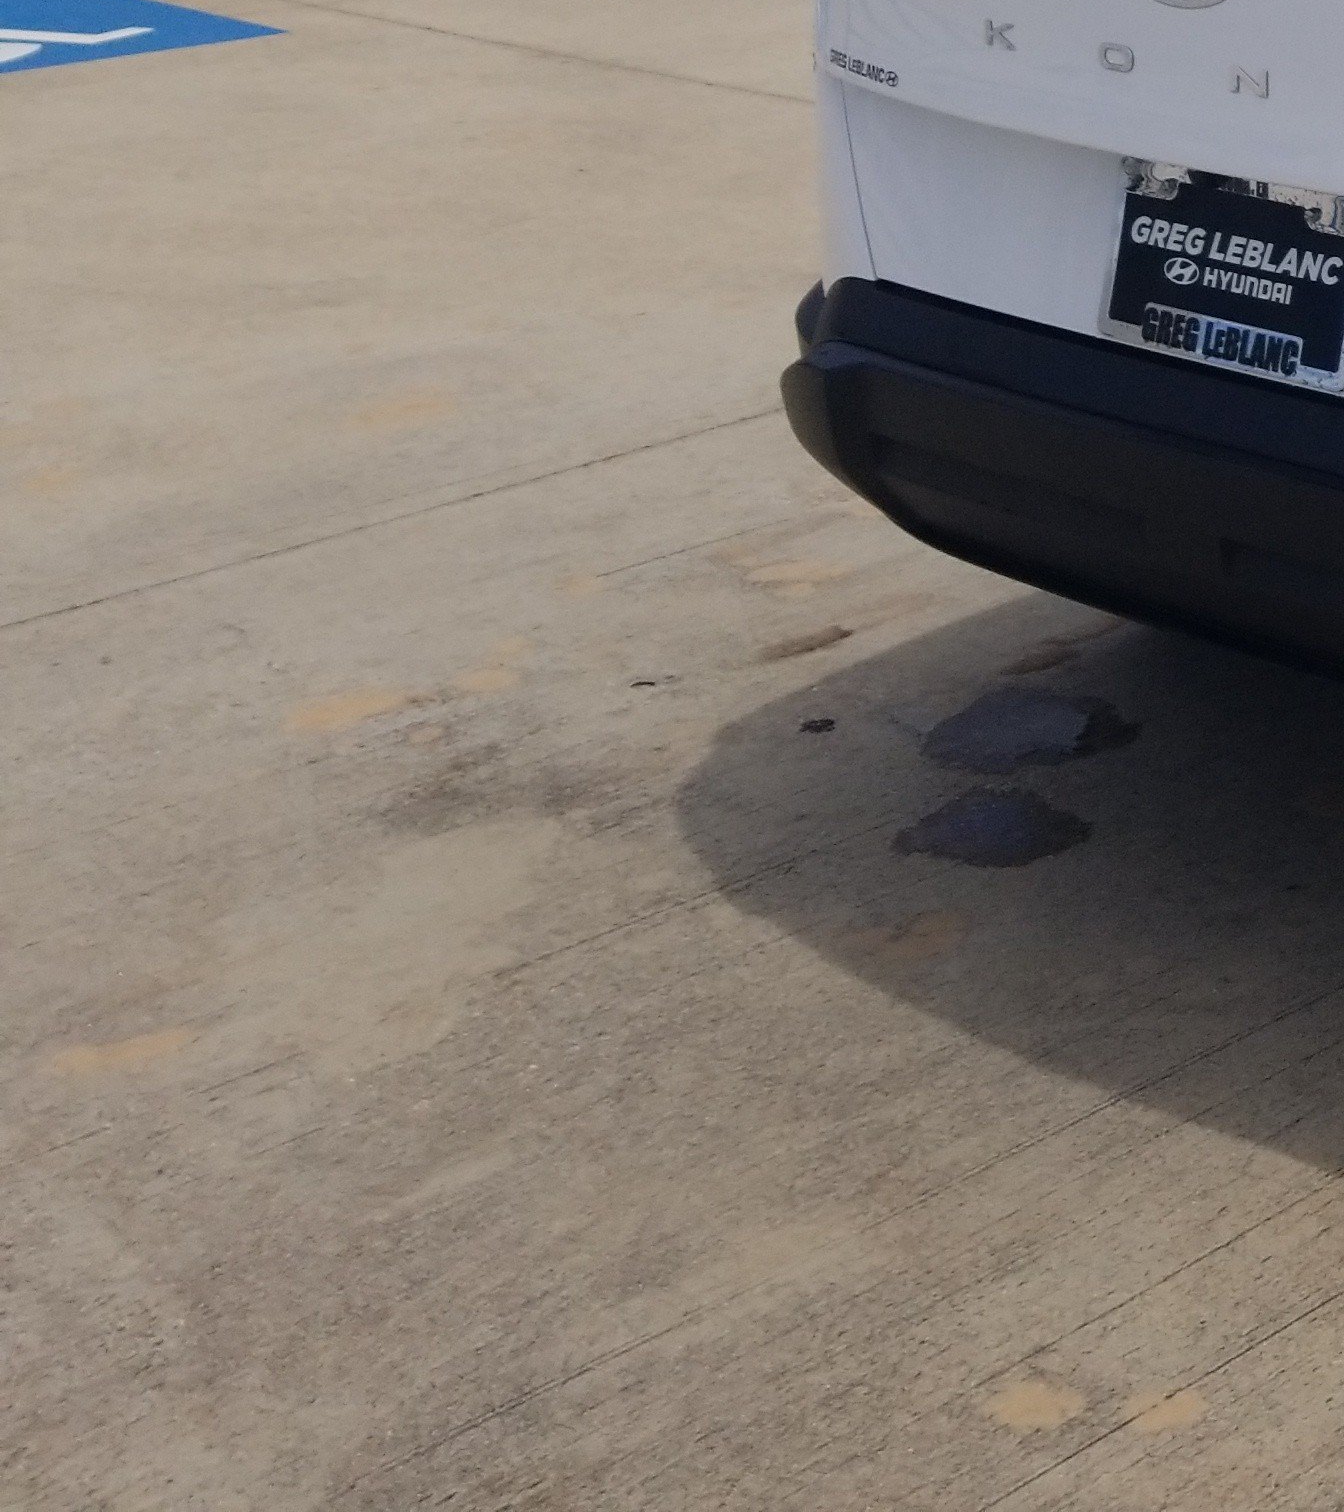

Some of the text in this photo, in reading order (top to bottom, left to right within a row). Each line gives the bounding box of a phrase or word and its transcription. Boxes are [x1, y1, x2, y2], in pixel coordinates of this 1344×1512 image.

[1131, 216, 1343, 285] GREG LEBLANC
[1203, 267, 1293, 305] HYUNDAI
[1141, 307, 1200, 353] GREG
